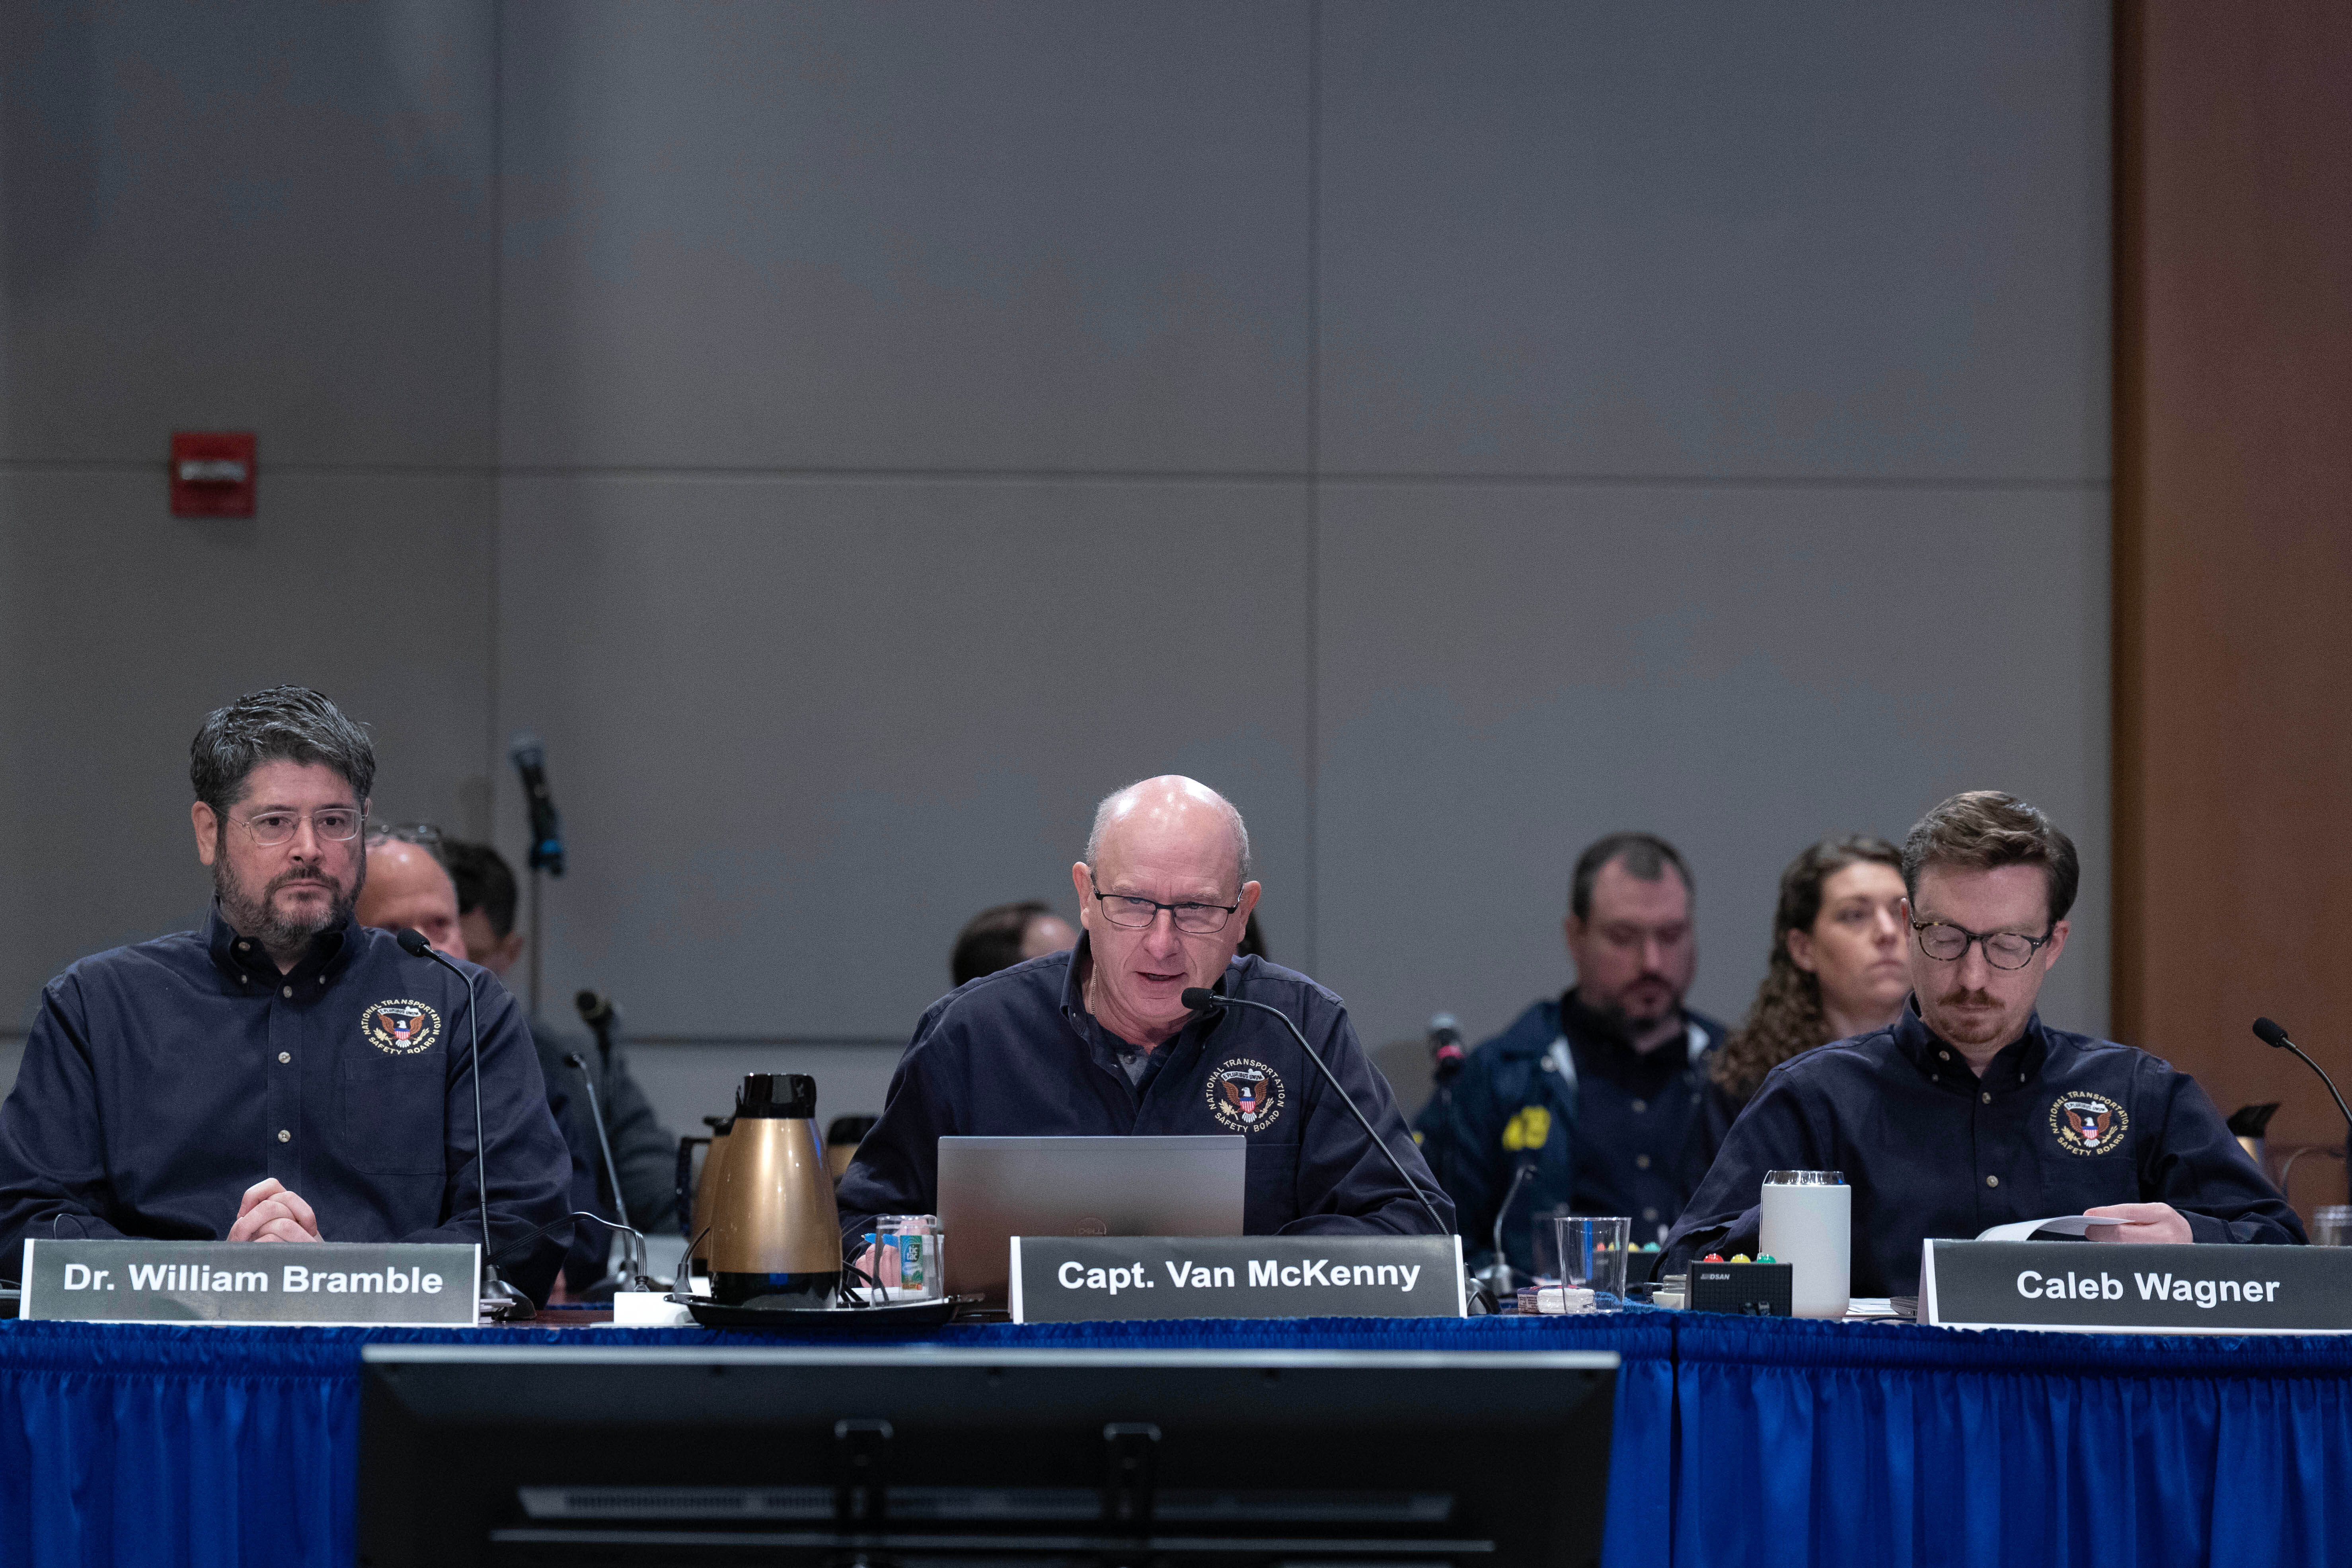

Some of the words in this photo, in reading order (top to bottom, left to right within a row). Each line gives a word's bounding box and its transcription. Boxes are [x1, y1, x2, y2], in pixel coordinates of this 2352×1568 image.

[361, 1004, 382, 1035] NATIONAL
[381, 999, 441, 1035] TRANSPORTATION
[368, 1037, 402, 1054] SAFETY
[407, 1037, 435, 1054] BOARD
[1206, 1067, 1224, 1110] NATIONAL
[1224, 1058, 1285, 1107] TRANSPORTATION
[1215, 1112, 1248, 1132] SAFETY
[1253, 1110, 1279, 1132] BOARD
[2050, 1096, 2068, 1134] NATIONAL
[2067, 1091, 2129, 1130] TRANSPORTATION
[2057, 1137, 2091, 1156] SAFETY
[2097, 1134, 2124, 1155] BOARD
[64, 1264, 115, 1290] Dr.
[129, 1264, 268, 1292] William
[283, 1266, 443, 1294] Bramble
[1059, 1262, 1154, 1295] Capt.
[1166, 1261, 1235, 1288] Van
[1249, 1260, 1421, 1292] McKenny
[2017, 1271, 2123, 1300] Caleb
[2134, 1273, 2280, 1308] Wagner
